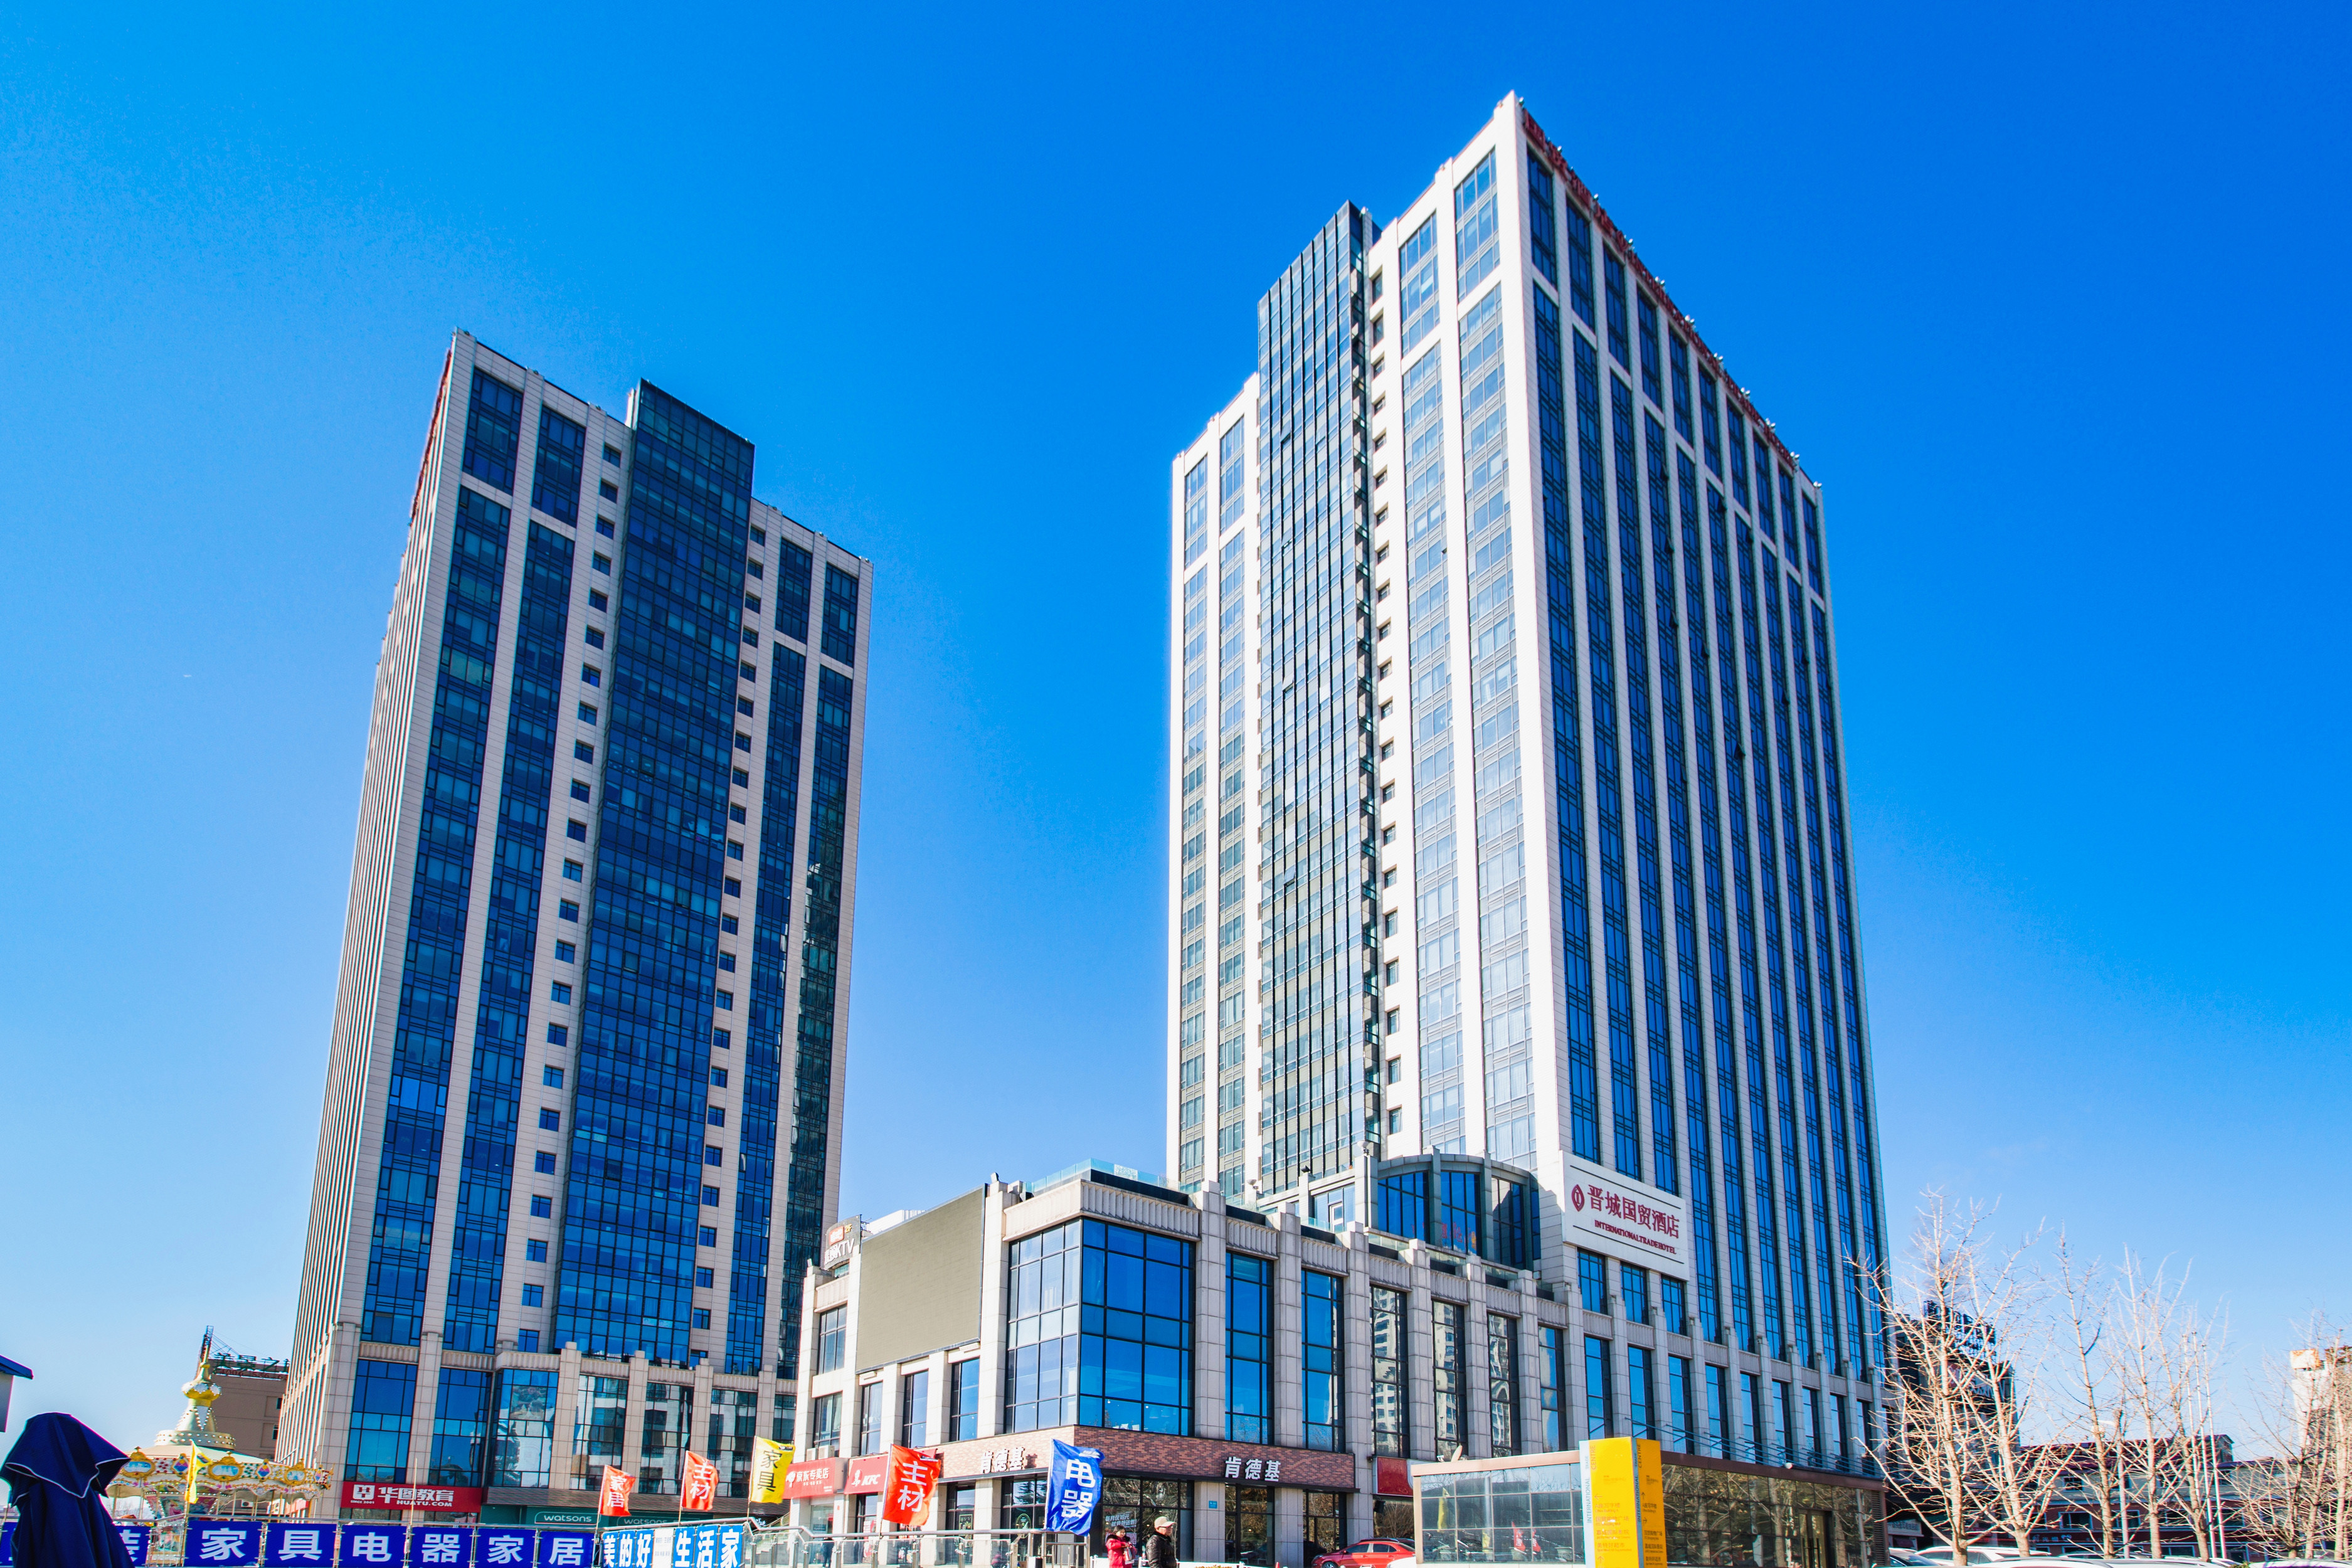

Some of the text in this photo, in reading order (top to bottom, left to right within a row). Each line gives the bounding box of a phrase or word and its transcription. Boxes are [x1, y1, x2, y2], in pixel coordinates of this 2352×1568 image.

[1587, 1184, 1680, 1239] 晋城国贸酒店
[757, 1450, 783, 1492] 家具
[981, 1446, 1025, 1474] 肯德基
[1225, 1456, 1281, 1482] 肯德基
[689, 1459, 714, 1500] 主材
[796, 1468, 830, 1483] 京东专卖店
[861, 1473, 881, 1486] KFC
[898, 1461, 928, 1512] 主材
[1061, 1458, 1096, 1518] 电器
[378, 1486, 455, 1504] 华图教育
[607, 1475, 627, 1508] 家居
[543, 1514, 592, 1523] watsons
